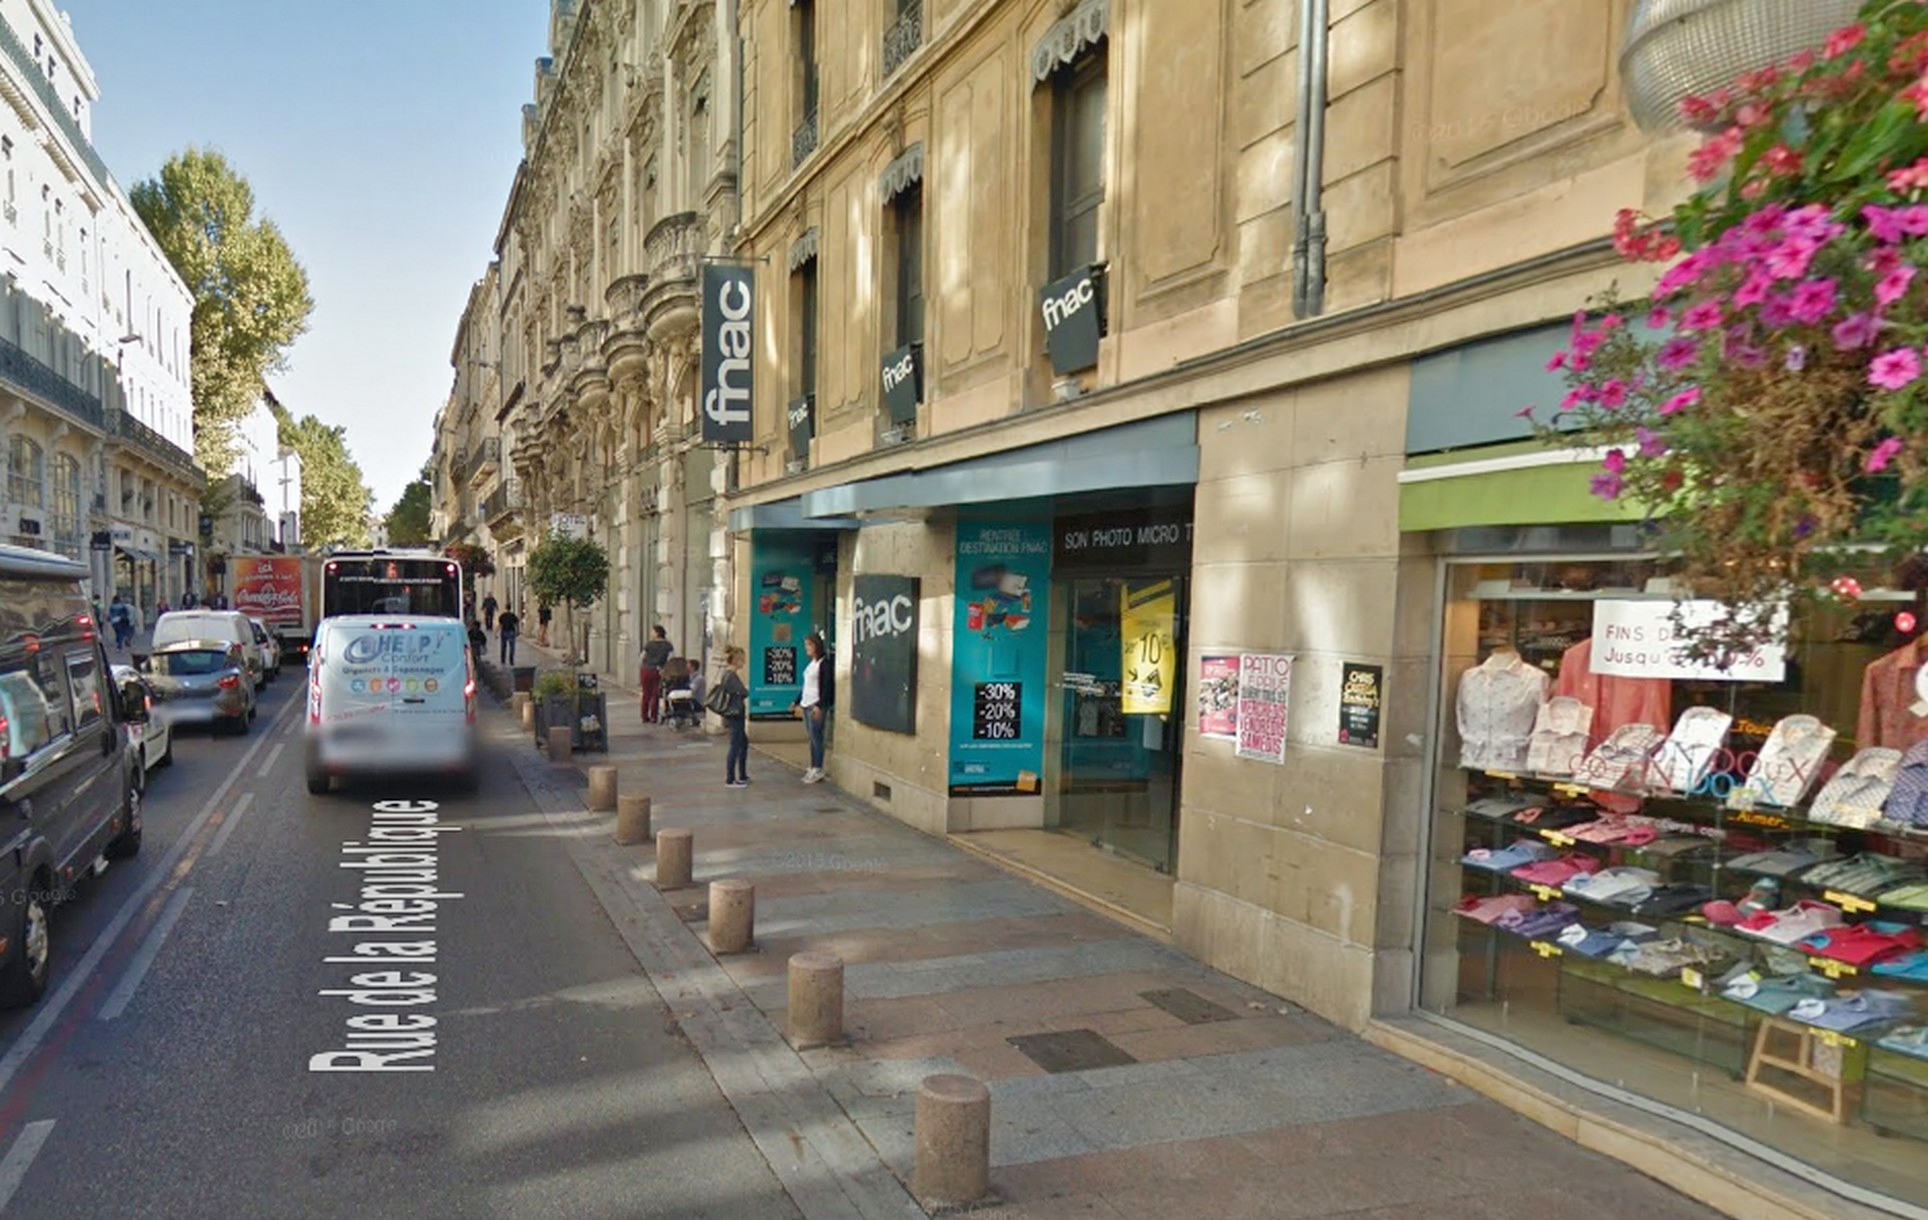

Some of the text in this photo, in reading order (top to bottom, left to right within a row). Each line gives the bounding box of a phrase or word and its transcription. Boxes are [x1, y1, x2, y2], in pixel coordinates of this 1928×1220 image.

[1042, 279, 1093, 331] fnac
[706, 280, 751, 426] fnac
[882, 354, 913, 392] fnac
[1065, 531, 1088, 549] SON
[1092, 528, 1132, 547] PHOTO
[1137, 524, 1179, 544] MICRO
[853, 595, 912, 645] fnac
[1605, 624, 1645, 641] FINS
[1244, 656, 1289, 676] PATIO
[768, 673, 793, 683] -10%
[979, 683, 1016, 700] -30%
[979, 702, 1016, 720] -20%
[979, 722, 1015, 738] -10%
[1241, 731, 1282, 754] SAMEDIS
